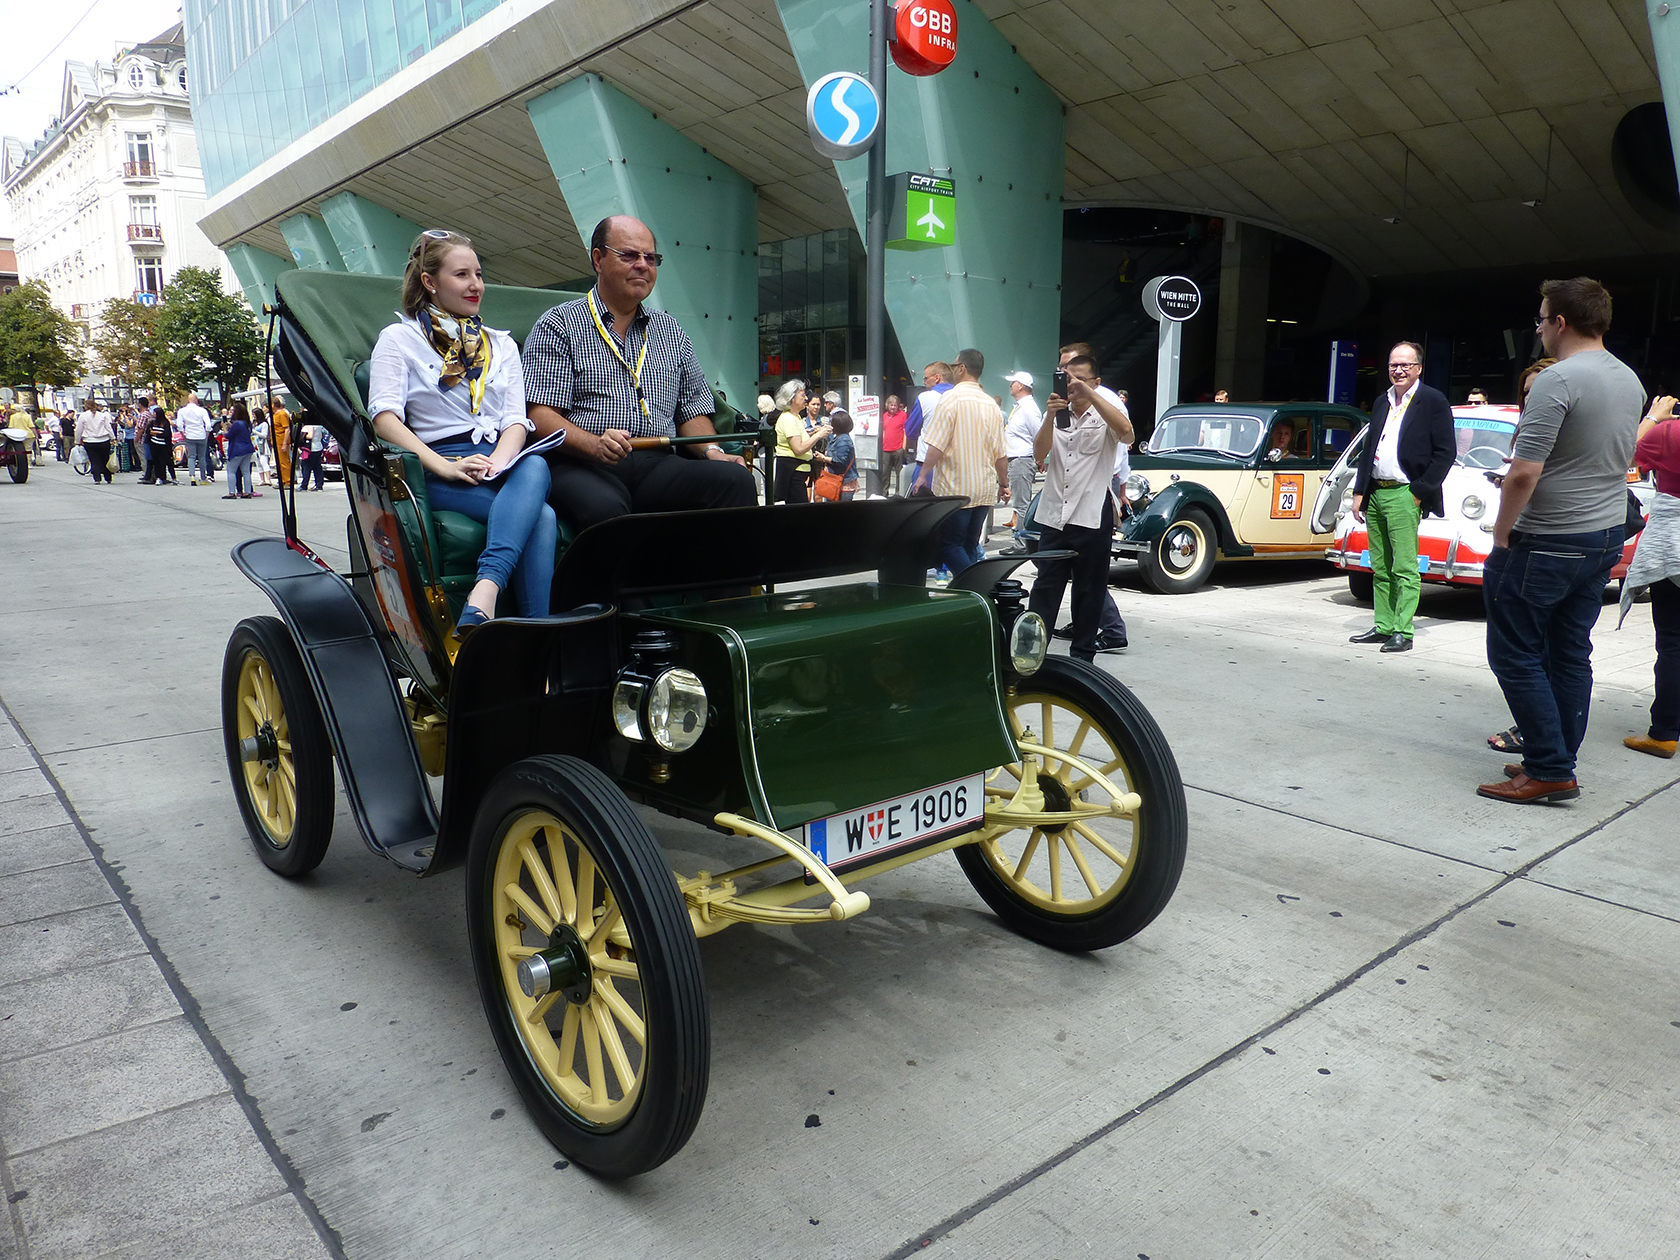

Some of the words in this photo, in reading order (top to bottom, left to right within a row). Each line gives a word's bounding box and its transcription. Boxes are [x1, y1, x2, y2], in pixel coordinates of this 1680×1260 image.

[928, 34, 956, 52] INFRA
[910, 174, 940, 188] CAT
[921, 186, 940, 194] AIRPORT
[1160, 290, 1178, 300] WIEN
[1178, 292, 1197, 302] MITTE
[1281, 493, 1294, 510] 29
[845, 814, 865, 853] W
[888, 804, 902, 841] E
[910, 785, 967, 832] 1906
